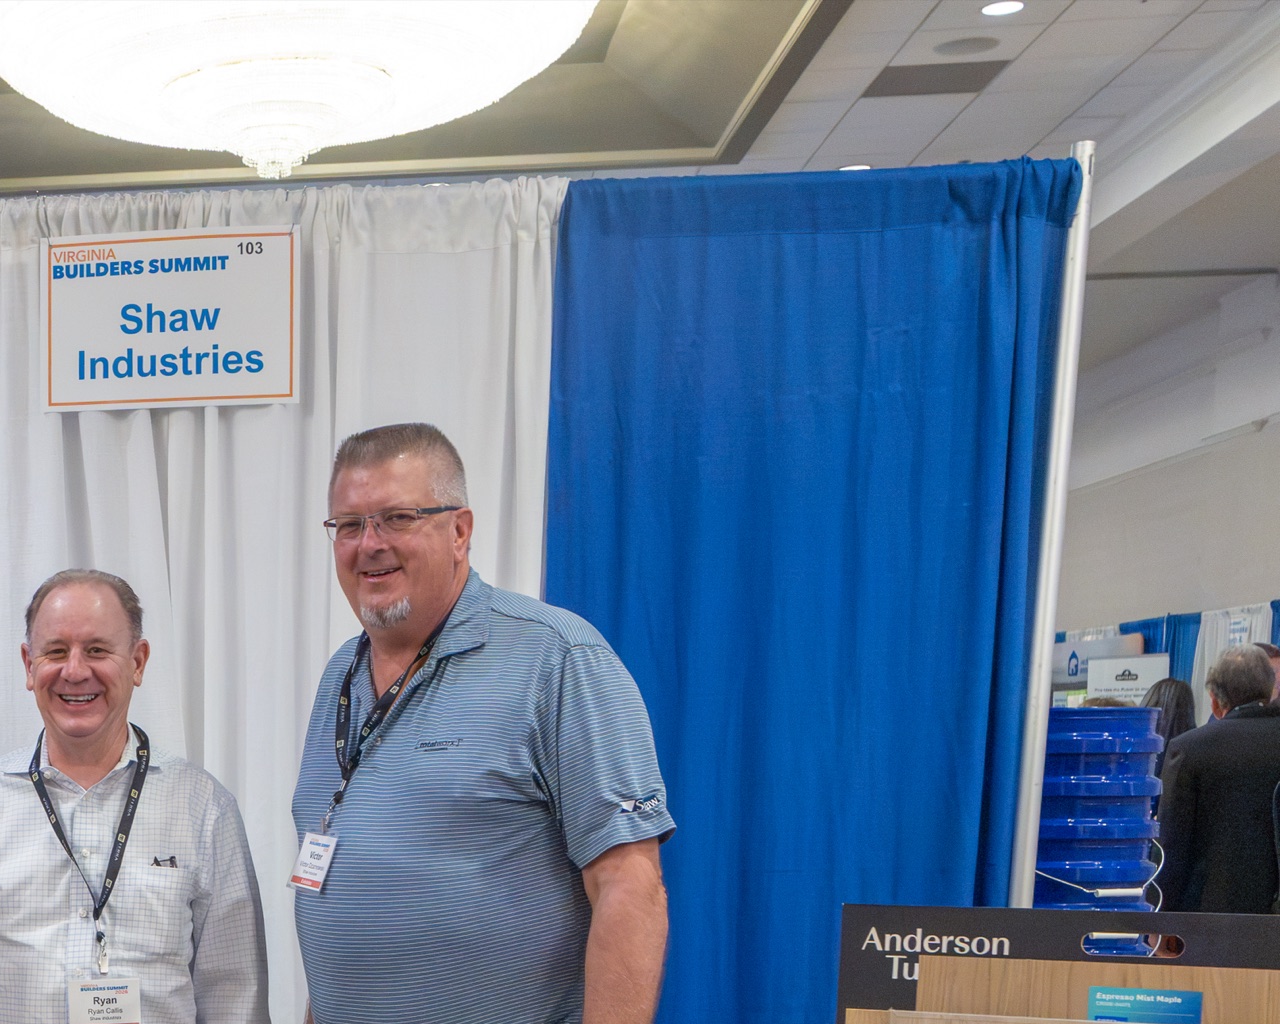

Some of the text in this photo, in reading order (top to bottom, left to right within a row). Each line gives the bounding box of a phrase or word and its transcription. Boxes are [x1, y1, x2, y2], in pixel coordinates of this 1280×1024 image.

[53, 249, 116, 263] VIRGINIA
[237, 242, 263, 254] 103
[53, 256, 229, 279] BUILDERS SUMMIT
[120, 303, 220, 334] Shaw
[78, 344, 264, 380] Industries
[861, 926, 1010, 955] Anderson
[93, 997, 117, 1006] Ryan
[1096, 992, 1182, 1004] Espresso Mist Maple
